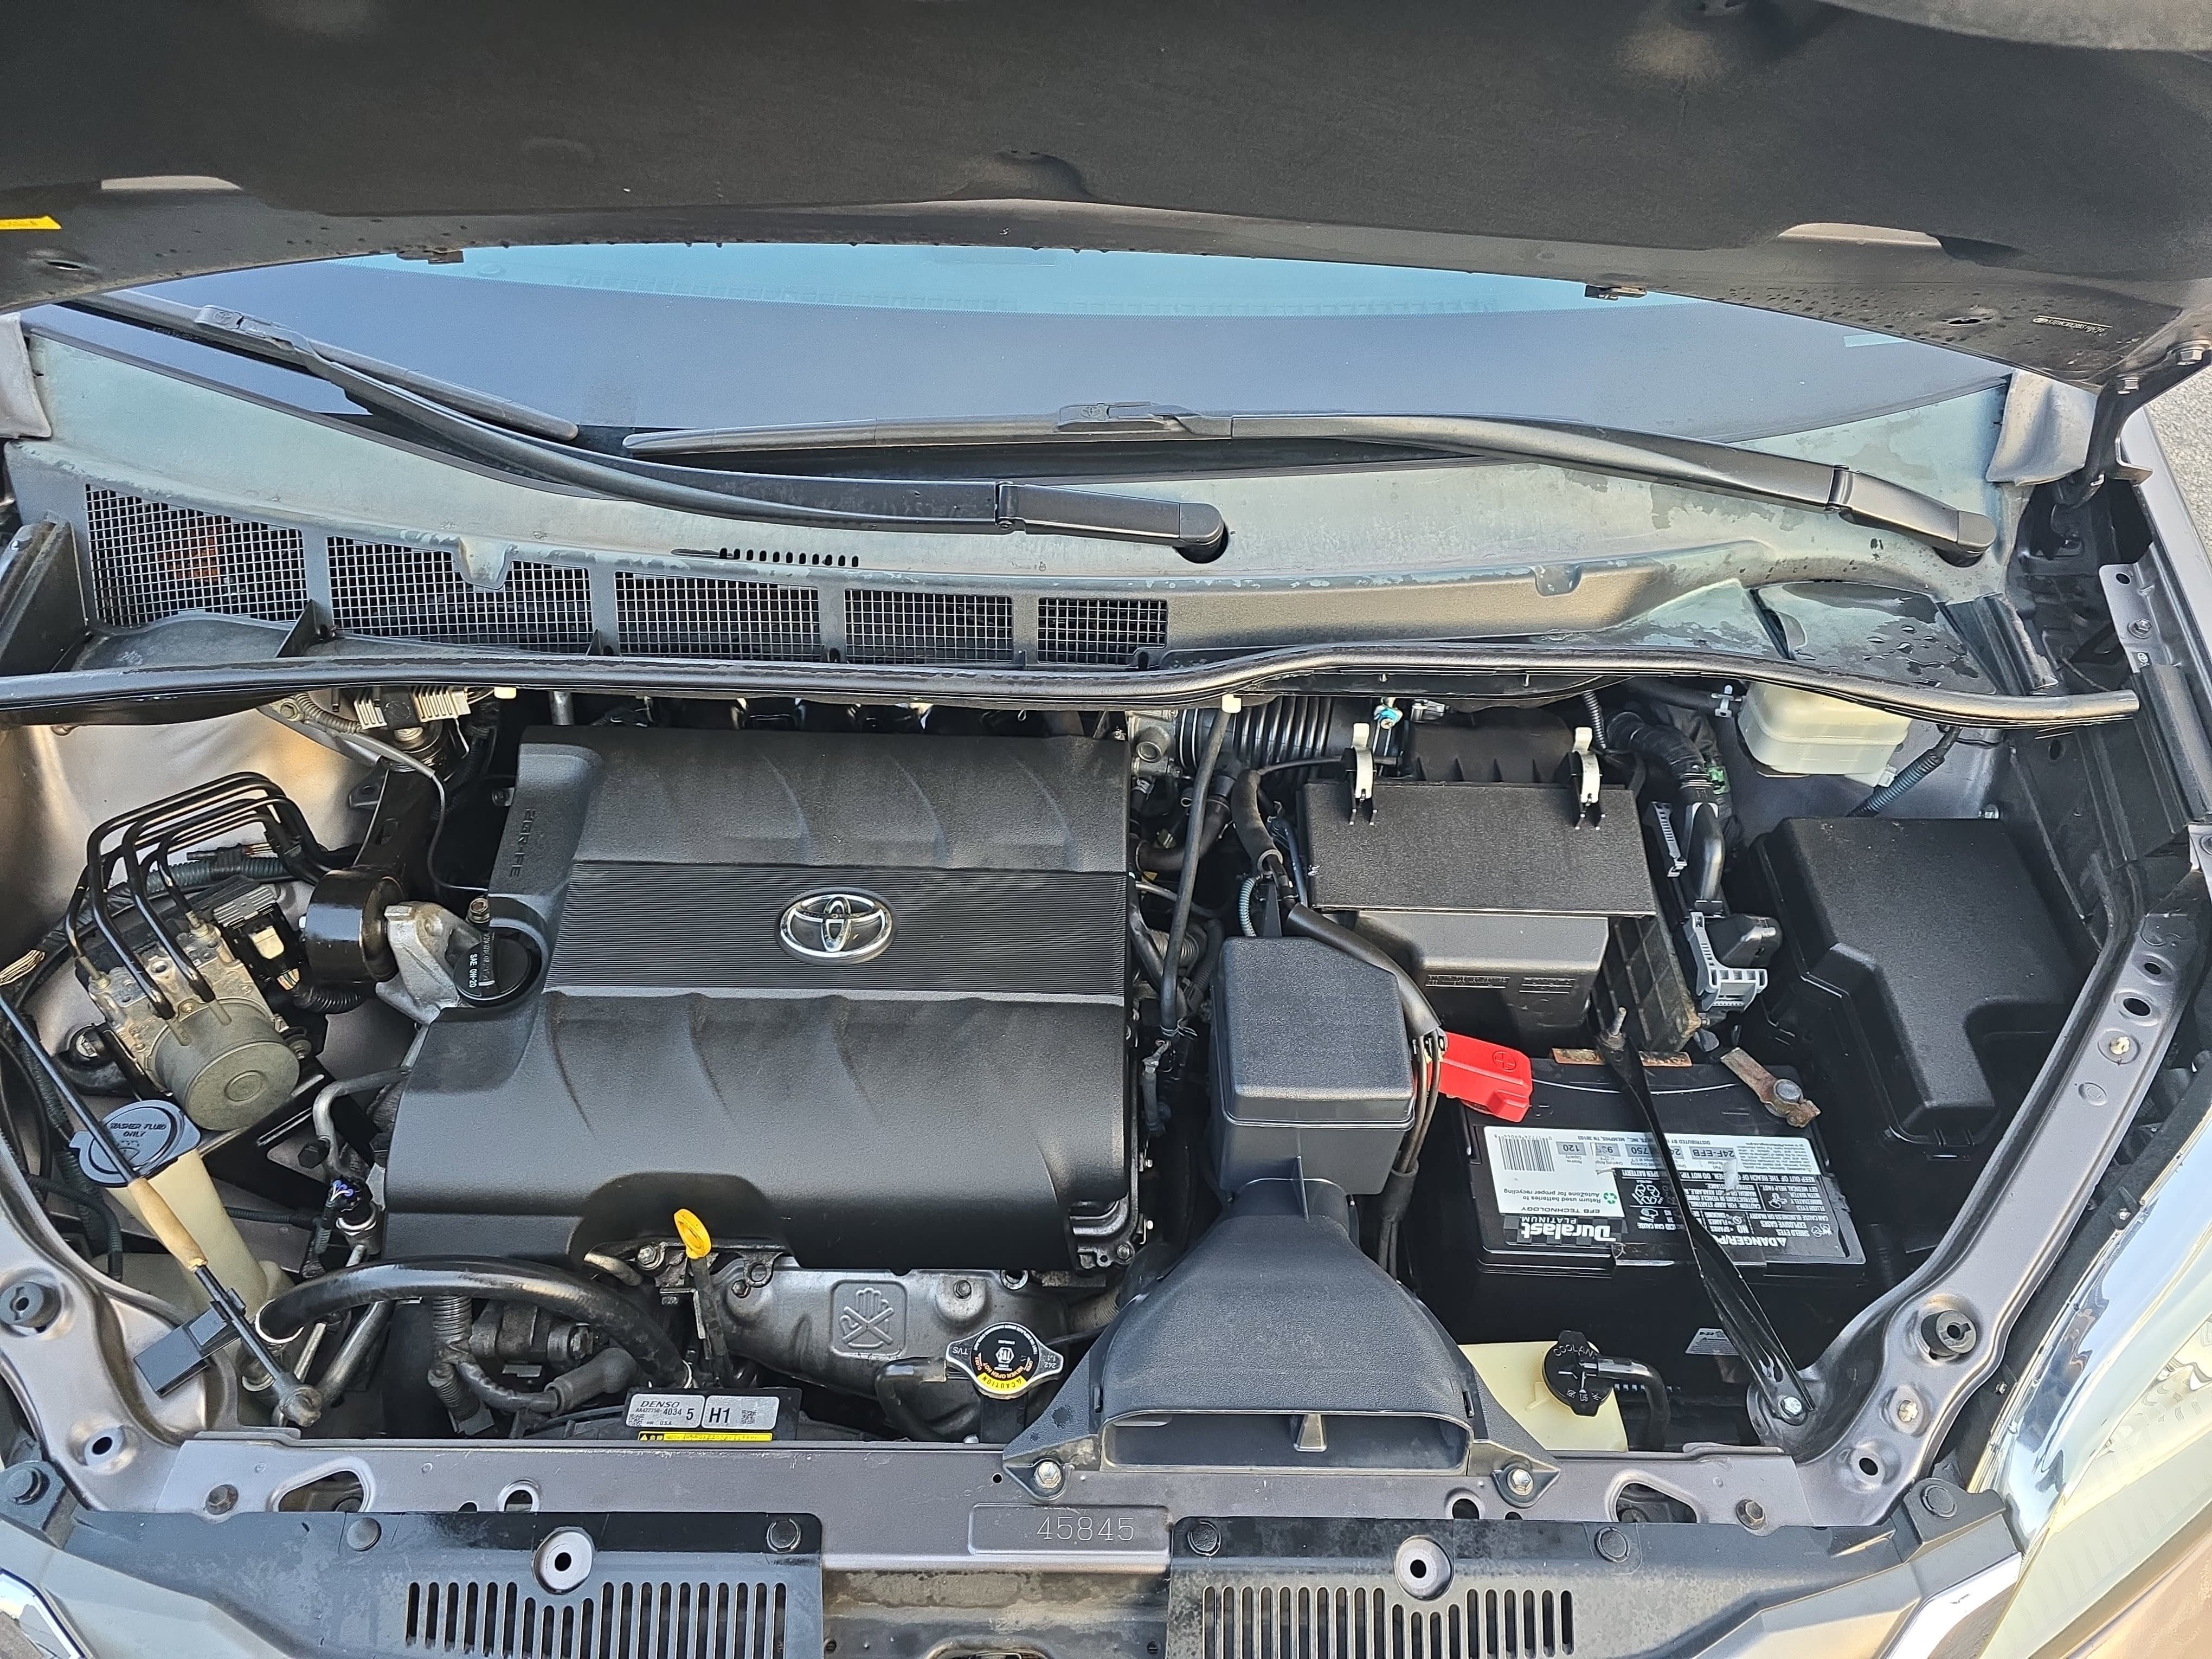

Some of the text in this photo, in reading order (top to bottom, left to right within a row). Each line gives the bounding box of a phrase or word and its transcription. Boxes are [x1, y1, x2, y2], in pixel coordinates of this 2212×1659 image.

[468, 954, 478, 988] SAE 0W-20
[1631, 1147, 1649, 1155] 750
[1692, 1149, 1734, 1158] 24F-EFB
[1637, 1221, 1655, 1230] CAUSE
[1736, 1225, 1750, 1234] NO
[1760, 1220, 1808, 1229] EXPLOSIVE GASES
[1521, 1222, 1617, 1243] Duralast
[1776, 1229, 1810, 1237] SHIELD EYES
[951, 1347, 969, 1356] TVS
[998, 1349, 1012, 1361] TVS
[982, 1362, 993, 1373] HOT
[1006, 1365, 1024, 1379] NEVER
[991, 1370, 1007, 1380] OPEN
[981, 1375, 1016, 1389] CAUTION
[686, 1408, 695, 1420] 5
[709, 1407, 731, 1424] H1
[1036, 1515, 1135, 1541] 45845
